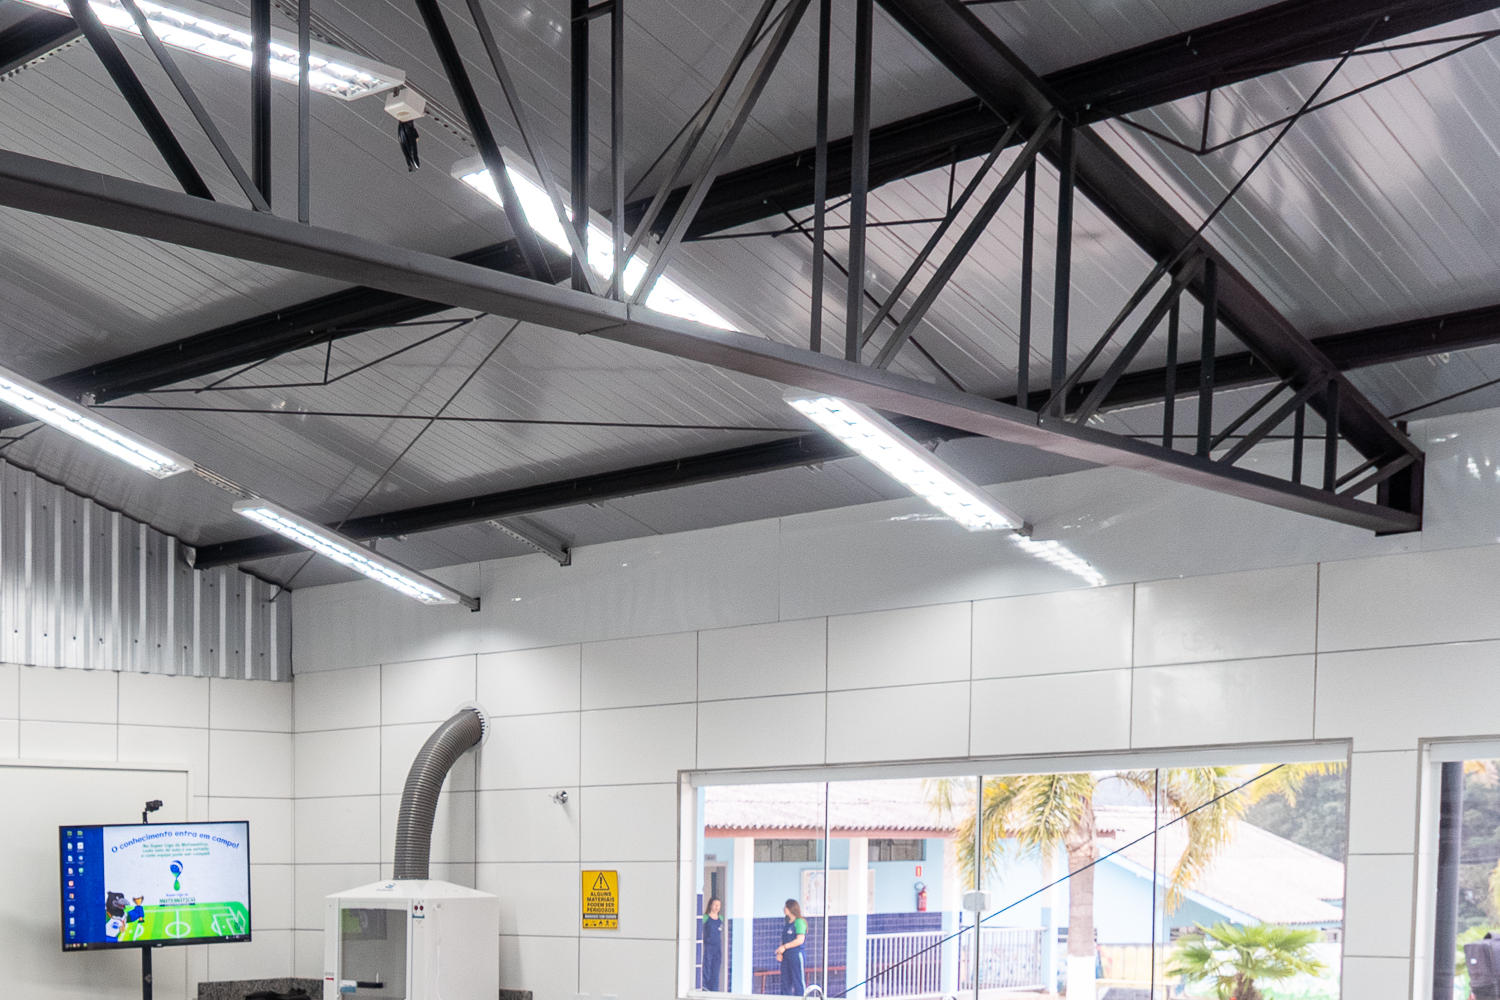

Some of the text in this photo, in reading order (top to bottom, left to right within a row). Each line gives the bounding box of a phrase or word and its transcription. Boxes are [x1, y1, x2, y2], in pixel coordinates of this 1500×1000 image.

[111, 845, 118, 853] O
[119, 830, 173, 850] conhecimento
[174, 830, 197, 838] entra
[211, 836, 240, 850] campo!
